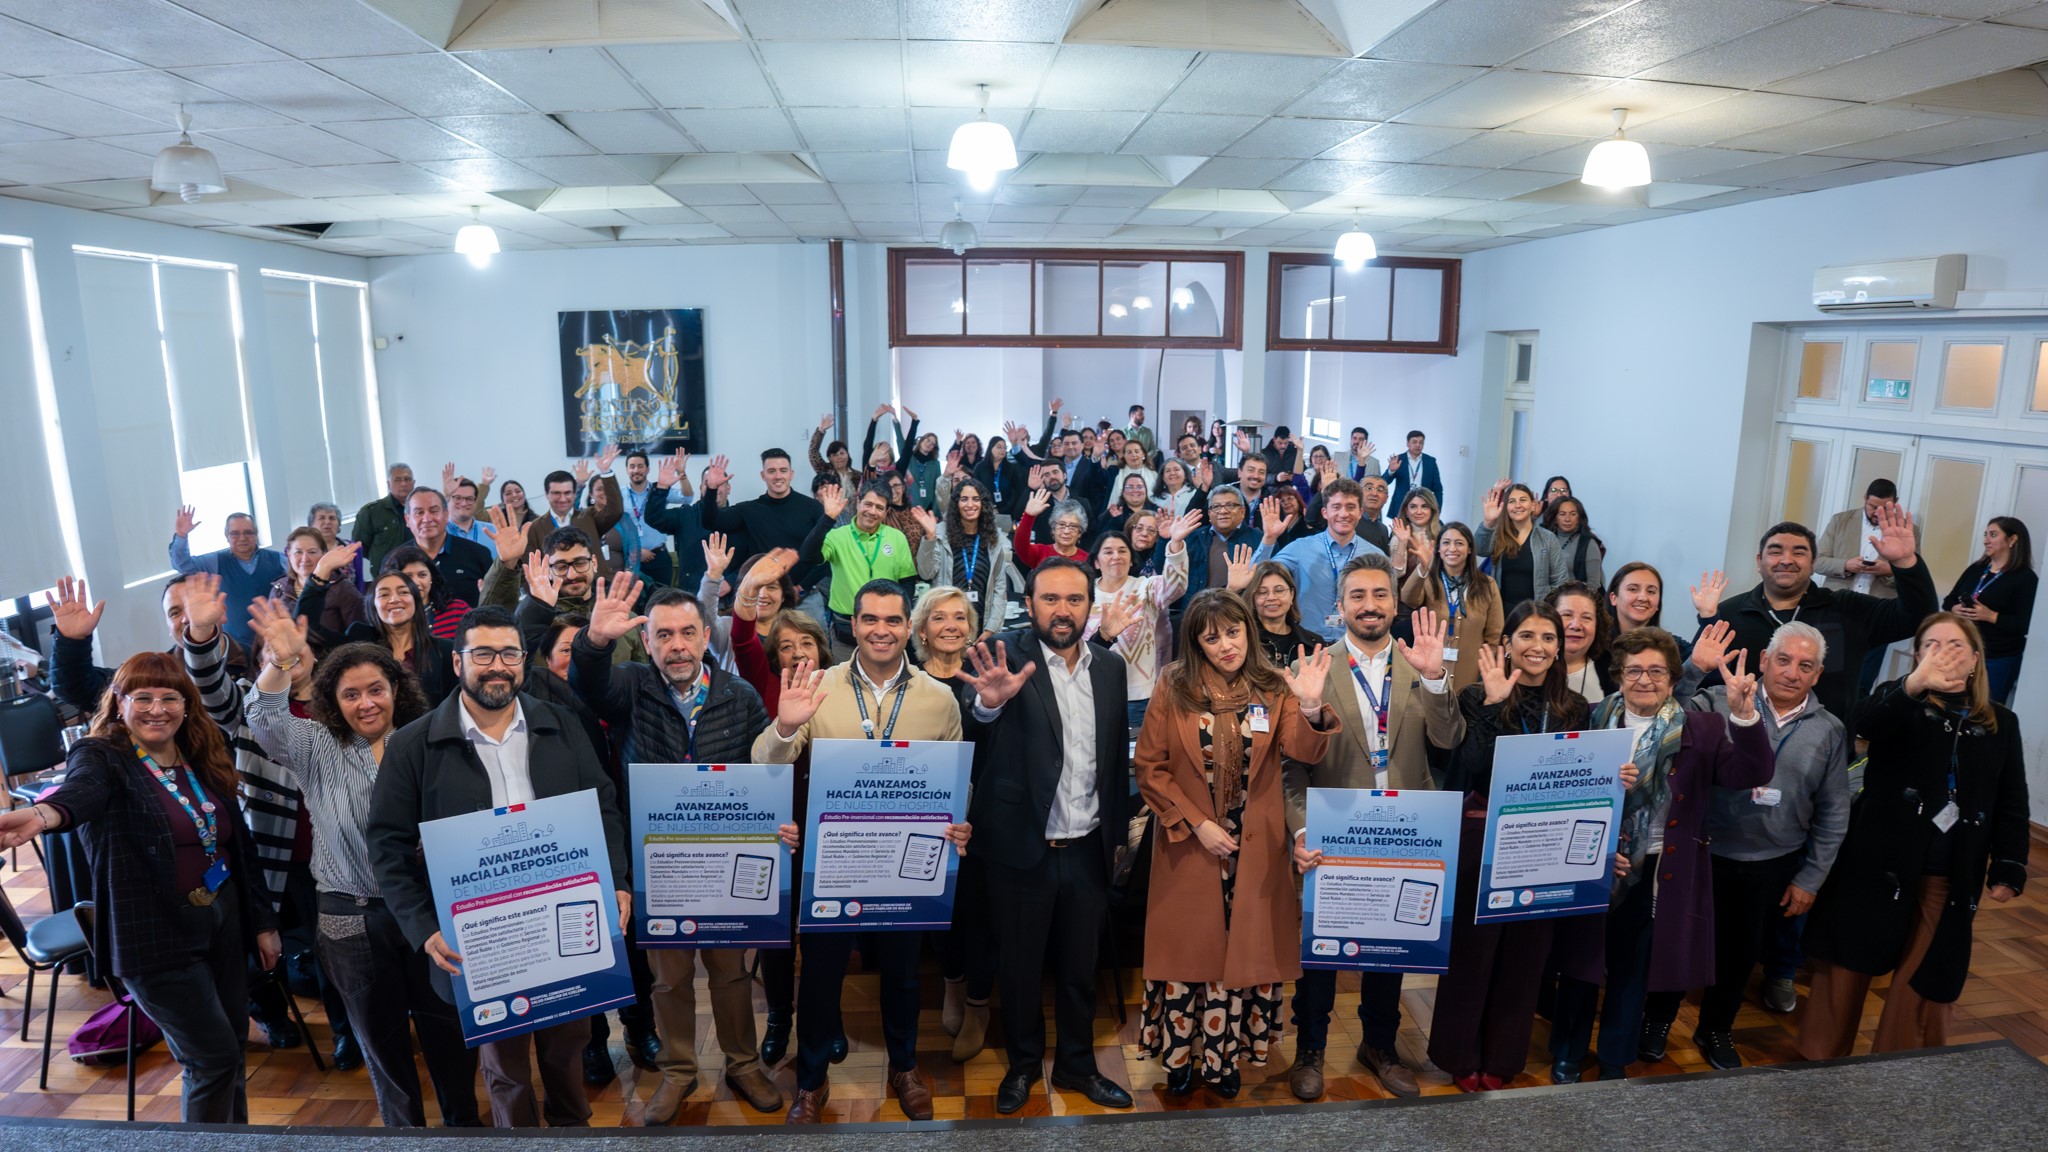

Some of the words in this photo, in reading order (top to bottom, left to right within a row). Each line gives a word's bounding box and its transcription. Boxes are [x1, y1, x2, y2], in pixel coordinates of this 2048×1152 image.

[581, 399, 660, 414] CENTRO
[579, 412, 689, 432] ESPAÑOL
[1530, 768, 1592, 780] AVANZAMOS
[854, 780, 926, 789] AVANZAMOS
[1506, 783, 1537, 792] HACIA
[1539, 782, 1550, 790] LA
[1553, 776, 1612, 789] REPOSICIÓN
[827, 790, 862, 798] HACIA
[865, 791, 878, 799] LA
[881, 789, 951, 799] REPOSICIÓN
[1505, 794, 1518, 803] DE
[1520, 790, 1565, 801] NUESTRO
[1568, 787, 1611, 798] HOSPITAL
[826, 801, 840, 810] DE
[844, 801, 896, 810] NUESTRO
[899, 801, 949, 810] HOSPITAL
[649, 813, 685, 821] HACIA
[687, 813, 701, 821] LA
[704, 811, 775, 821] REPOSICIÓN
[649, 823, 663, 832] DE
[667, 823, 719, 832] NUESTRO
[723, 823, 774, 831] HOSPITAL
[1348, 827, 1417, 836] AVANZAMOS
[1322, 836, 1356, 844] HACIA
[1358, 837, 1371, 845] LA
[1374, 837, 1442, 847] REPOSICIÓN
[479, 842, 558, 867] AVANZAMOS
[1322, 846, 1335, 854] DE
[1339, 847, 1388, 856] NUESTRO
[1392, 848, 1441, 858] HOSPITAL
[451, 870, 492, 886] HACIA
[493, 866, 510, 877] LA
[511, 848, 588, 873] REPOSICIÓN
[454, 886, 471, 899] DE
[474, 873, 531, 895] NUESTRO
[535, 861, 591, 880] HOSPITAL
[462, 921, 478, 932] ¿Qué
[479, 916, 506, 926] significa
[523, 905, 547, 916] avance?
